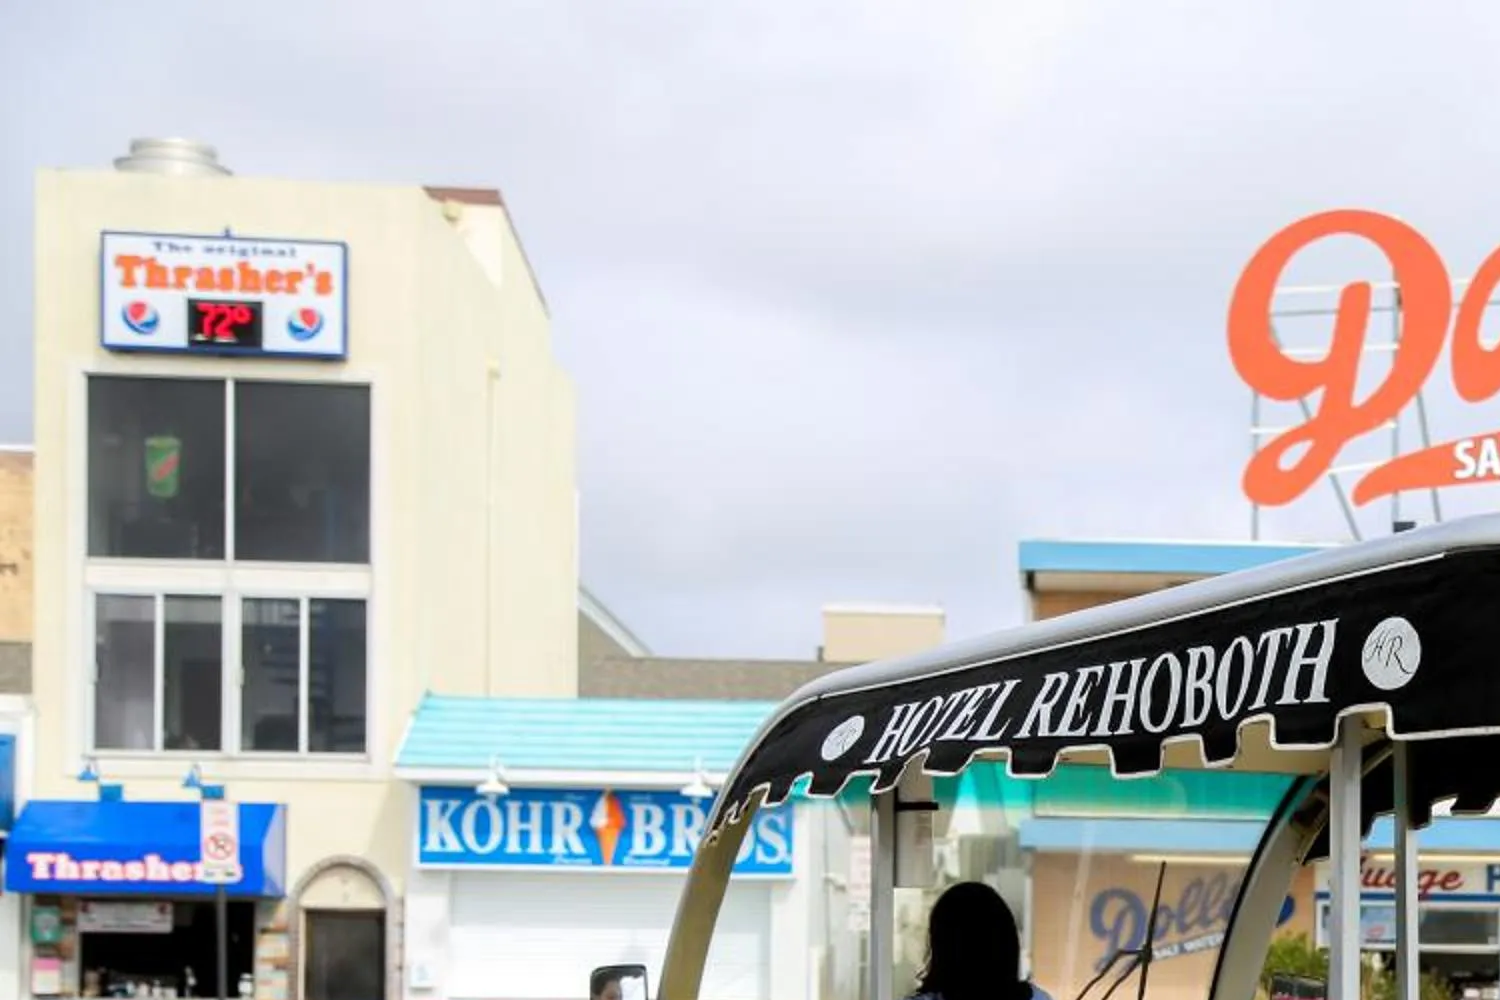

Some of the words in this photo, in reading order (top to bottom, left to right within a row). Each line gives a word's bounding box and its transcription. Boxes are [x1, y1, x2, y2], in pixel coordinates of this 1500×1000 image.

[153, 241, 194, 254] The
[114, 254, 333, 296] Thrasher's
[864, 679, 1022, 763] HOTEL
[1012, 618, 1340, 740] REHOBOTH
[424, 799, 587, 856] KOHR
